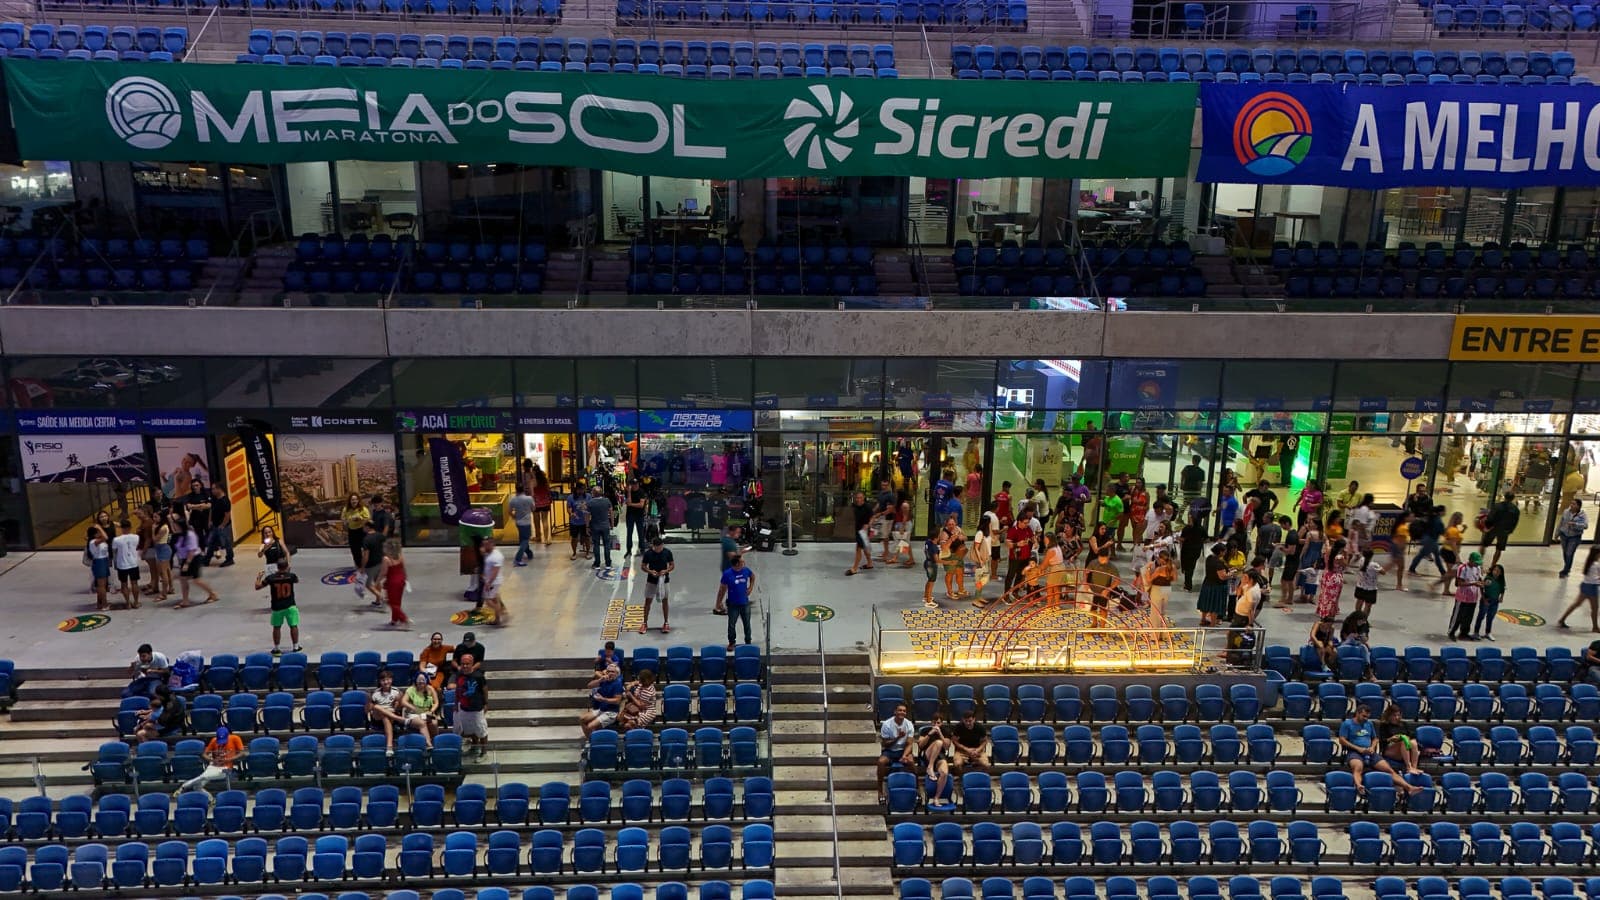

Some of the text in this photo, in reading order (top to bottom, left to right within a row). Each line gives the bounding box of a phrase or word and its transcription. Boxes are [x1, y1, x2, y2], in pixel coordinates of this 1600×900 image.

[191, 88, 726, 159] MEIA DO SOL
[874, 97, 1112, 160] Sicredi
[303, 129, 442, 144] MARATONA
[1341, 103, 1384, 173] A
[1461, 326, 1573, 353] ENTRE
[323, 417, 378, 425] CONSTEL
[594, 412, 616, 426] 10
[34, 442, 63, 450] FISIO
[254, 435, 274, 490] CONSTEL
[274, 583, 291, 599] 10
